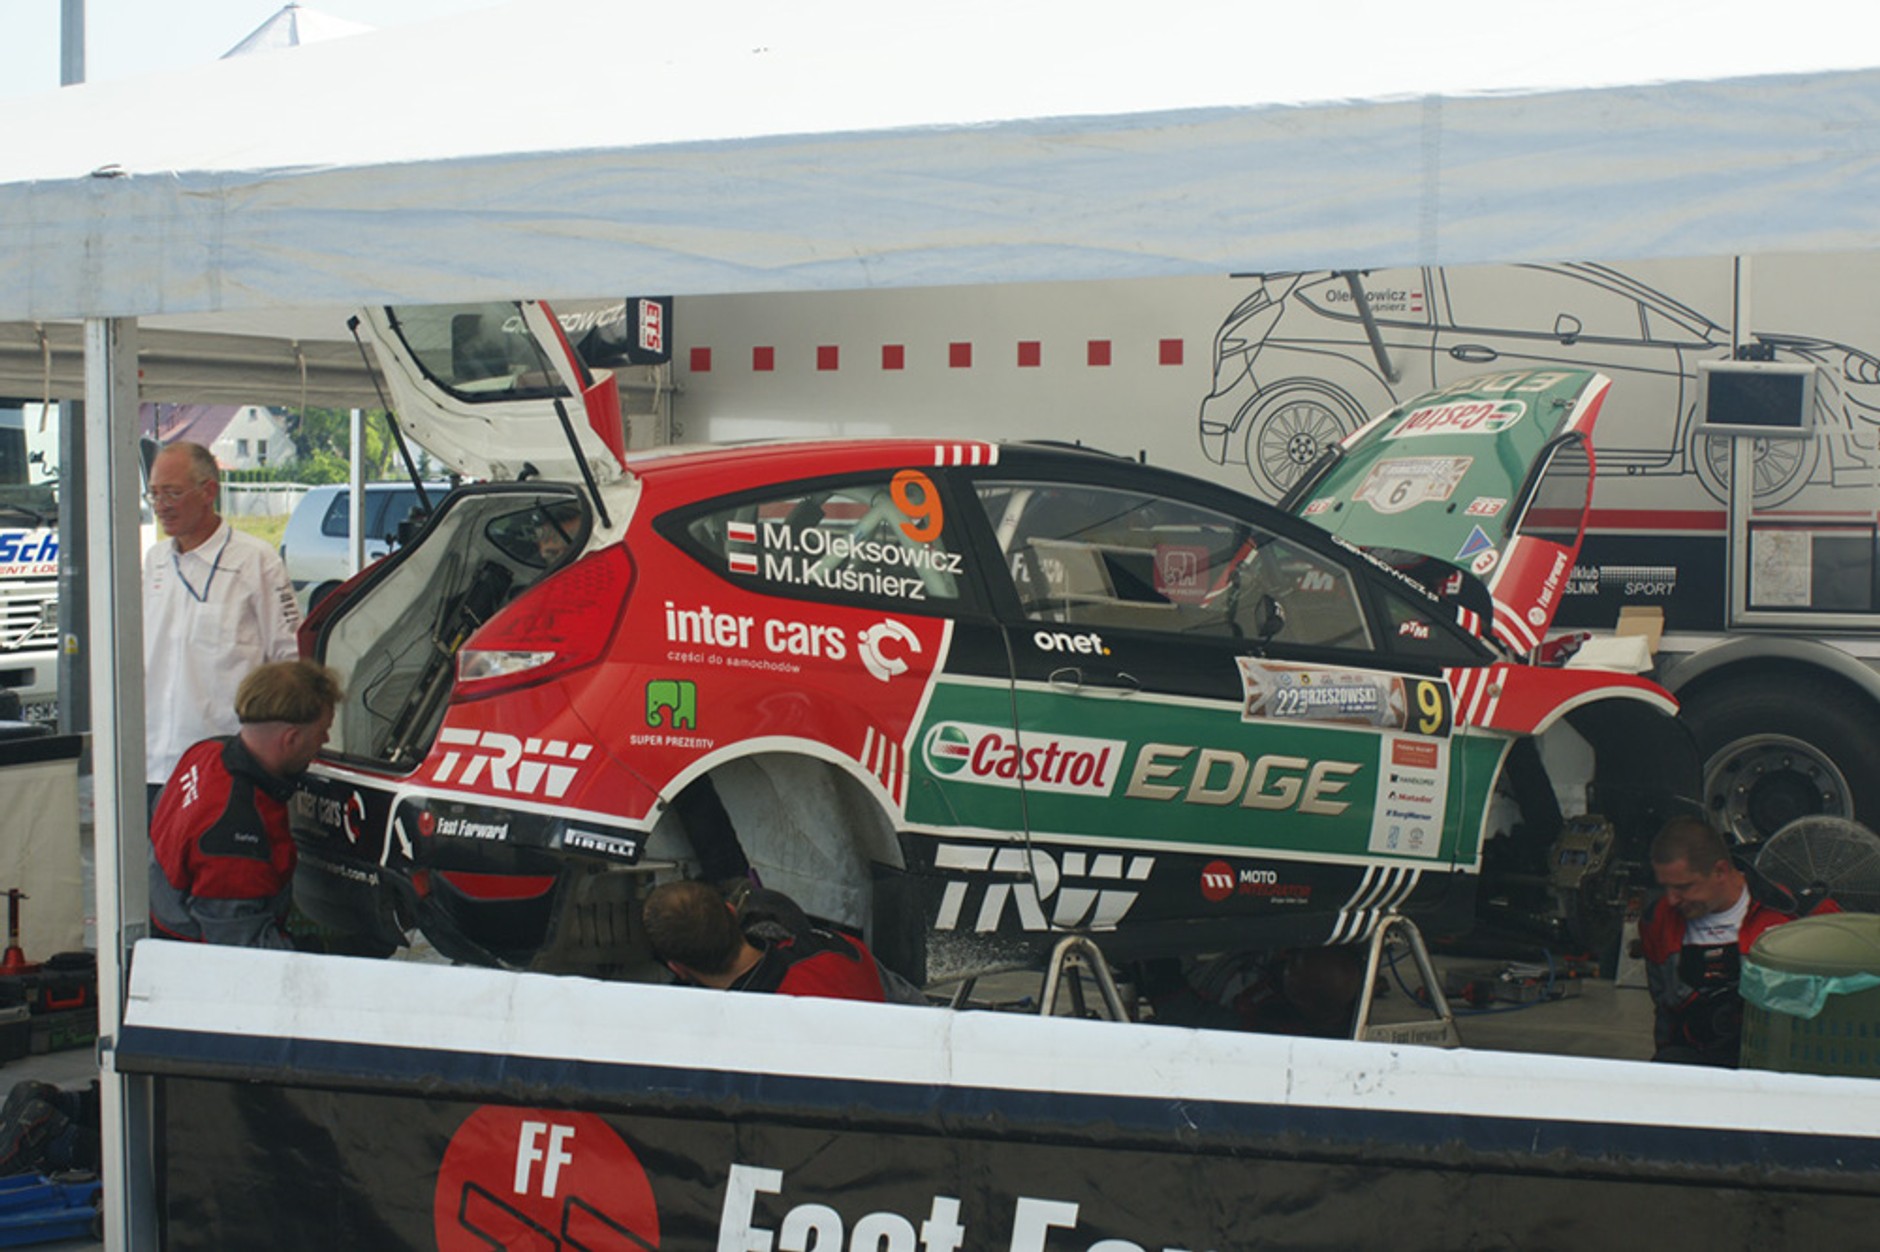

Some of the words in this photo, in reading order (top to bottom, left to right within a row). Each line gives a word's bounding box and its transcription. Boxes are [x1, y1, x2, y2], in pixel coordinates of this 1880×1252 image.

[646, 304, 661, 350] ETS
[1393, 404, 1495, 436] Castrol
[890, 470, 944, 543] 9
[1468, 503, 1501, 514] ETS
[763, 522, 964, 574] M.Oleksowicz
[764, 553, 926, 600] M.Kuśnierz
[1624, 582, 1675, 596] SPORT
[664, 601, 755, 649] inter
[763, 618, 847, 661] cars
[1033, 630, 1111, 656] onet.
[1399, 620, 1430, 639] PTM
[667, 651, 704, 664] części
[708, 653, 723, 665] do
[726, 658, 800, 673] samochodów
[1417, 680, 1443, 735] 9
[630, 735, 663, 746] SUPER
[665, 736, 714, 748] PREZENTY
[432, 727, 594, 799] TRW
[971, 733, 1109, 788] Castrol
[1124, 743, 1364, 816] EDGE
[436, 817, 457, 837] Fast
[457, 820, 508, 841] Forward
[564, 828, 637, 857] PIRELLI
[934, 842, 1156, 932] TRW
[1239, 869, 1277, 885] MOTO
[513, 1120, 575, 1198] FF
